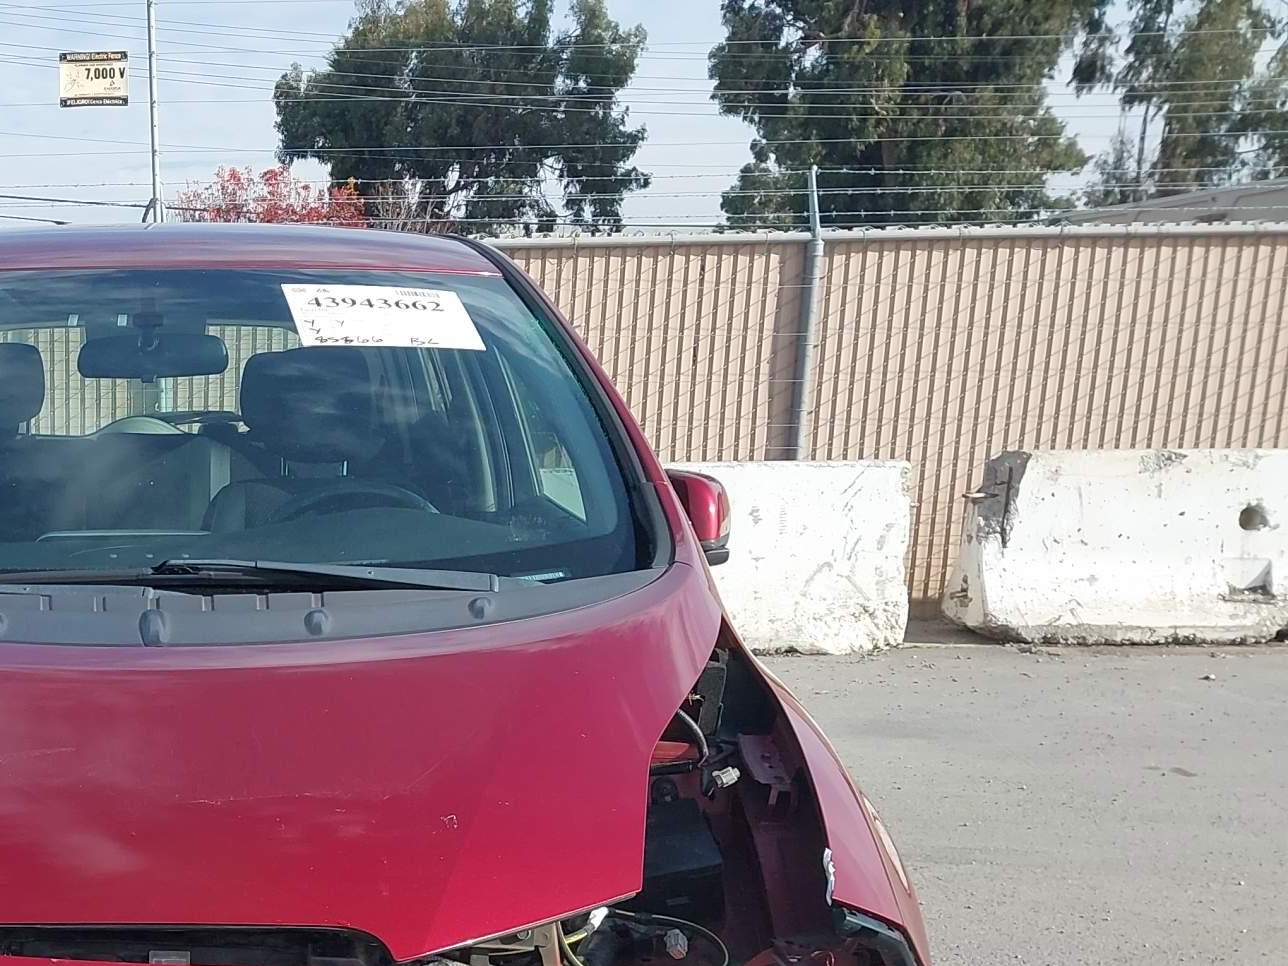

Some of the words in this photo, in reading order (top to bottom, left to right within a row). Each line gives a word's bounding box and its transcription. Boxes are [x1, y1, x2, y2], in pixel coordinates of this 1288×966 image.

[84, 67, 116, 81] 7,000
[119, 67, 125, 79] V
[307, 296, 444, 312] 43943662
